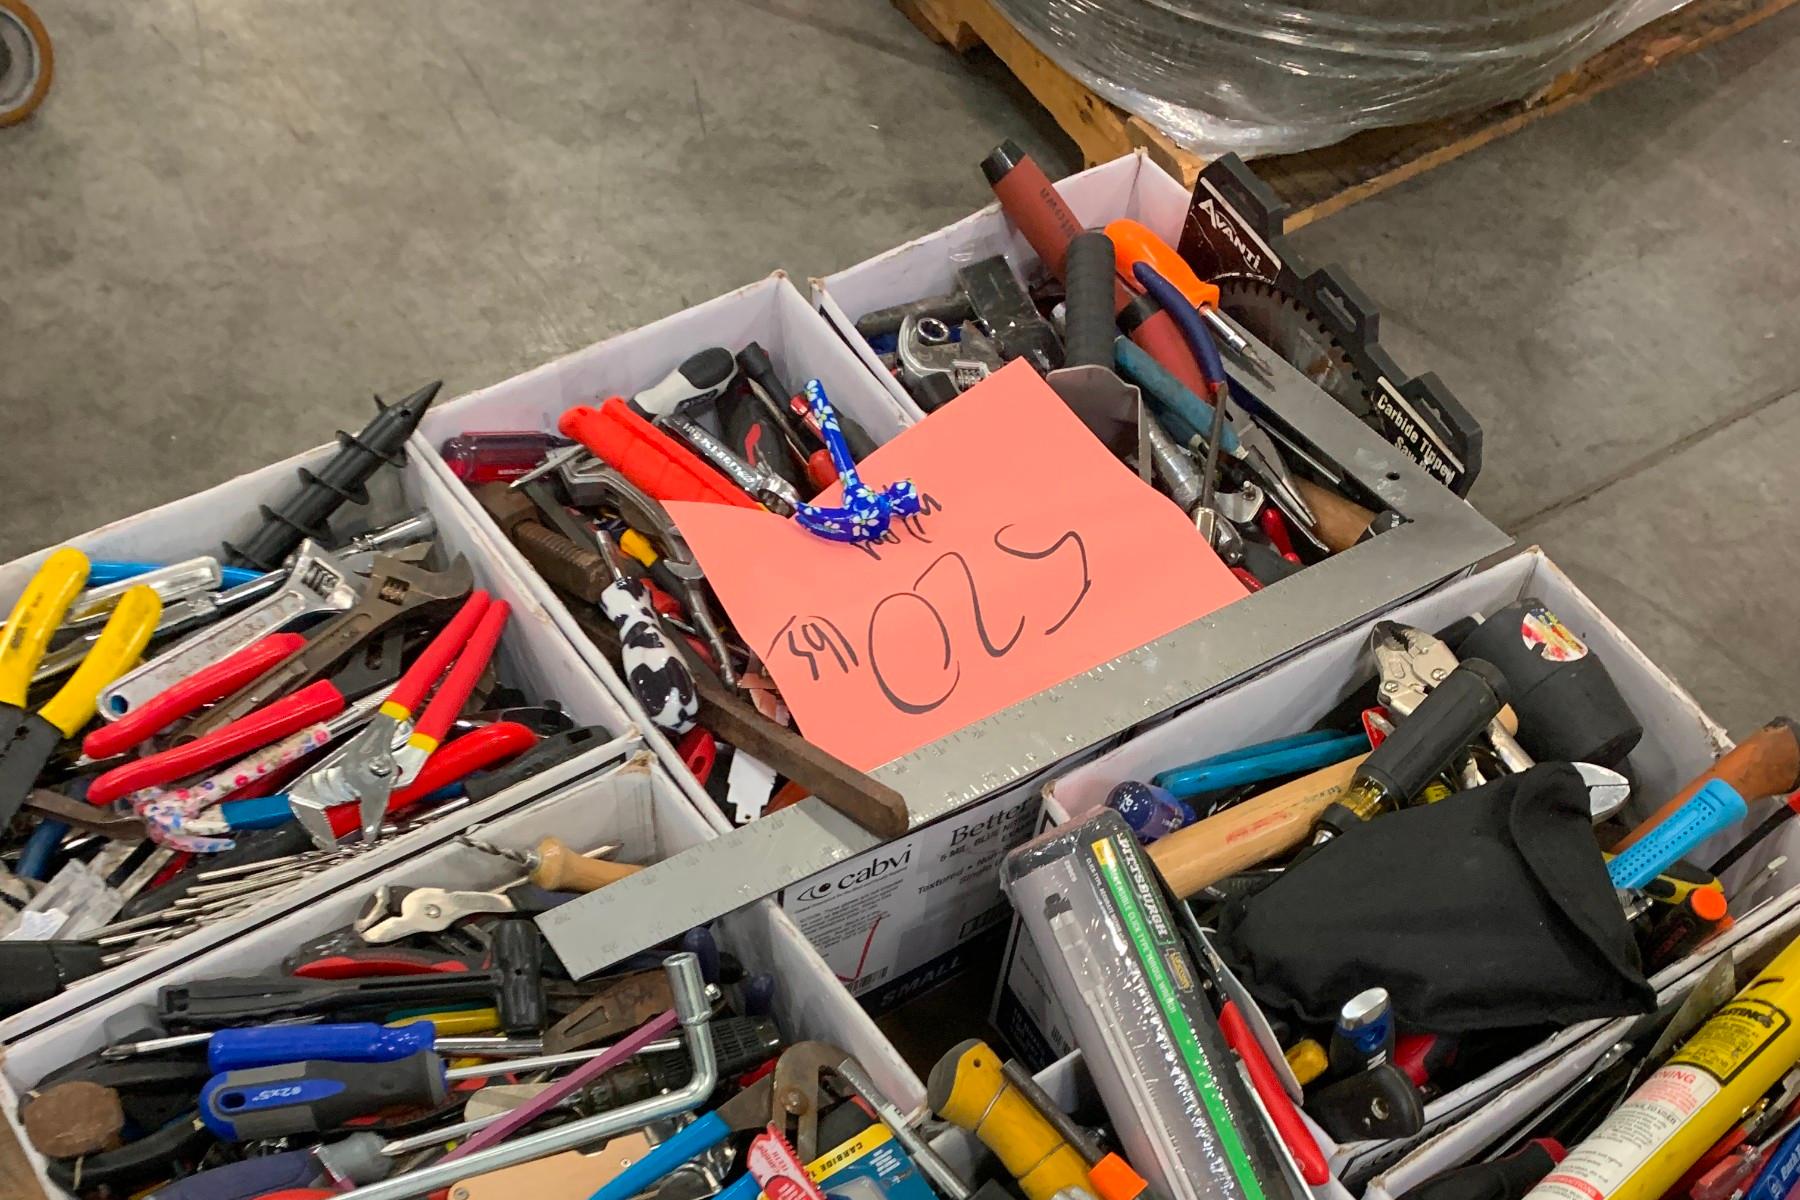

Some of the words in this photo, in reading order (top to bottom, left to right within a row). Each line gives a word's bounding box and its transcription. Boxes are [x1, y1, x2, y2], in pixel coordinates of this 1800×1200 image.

[1377, 394, 1419, 443] Carbide
[868, 523, 1091, 714] 520
[951, 796, 1032, 847] Better
[837, 842, 912, 890] cabvi
[1116, 831, 1169, 937] PITTSBURGH
